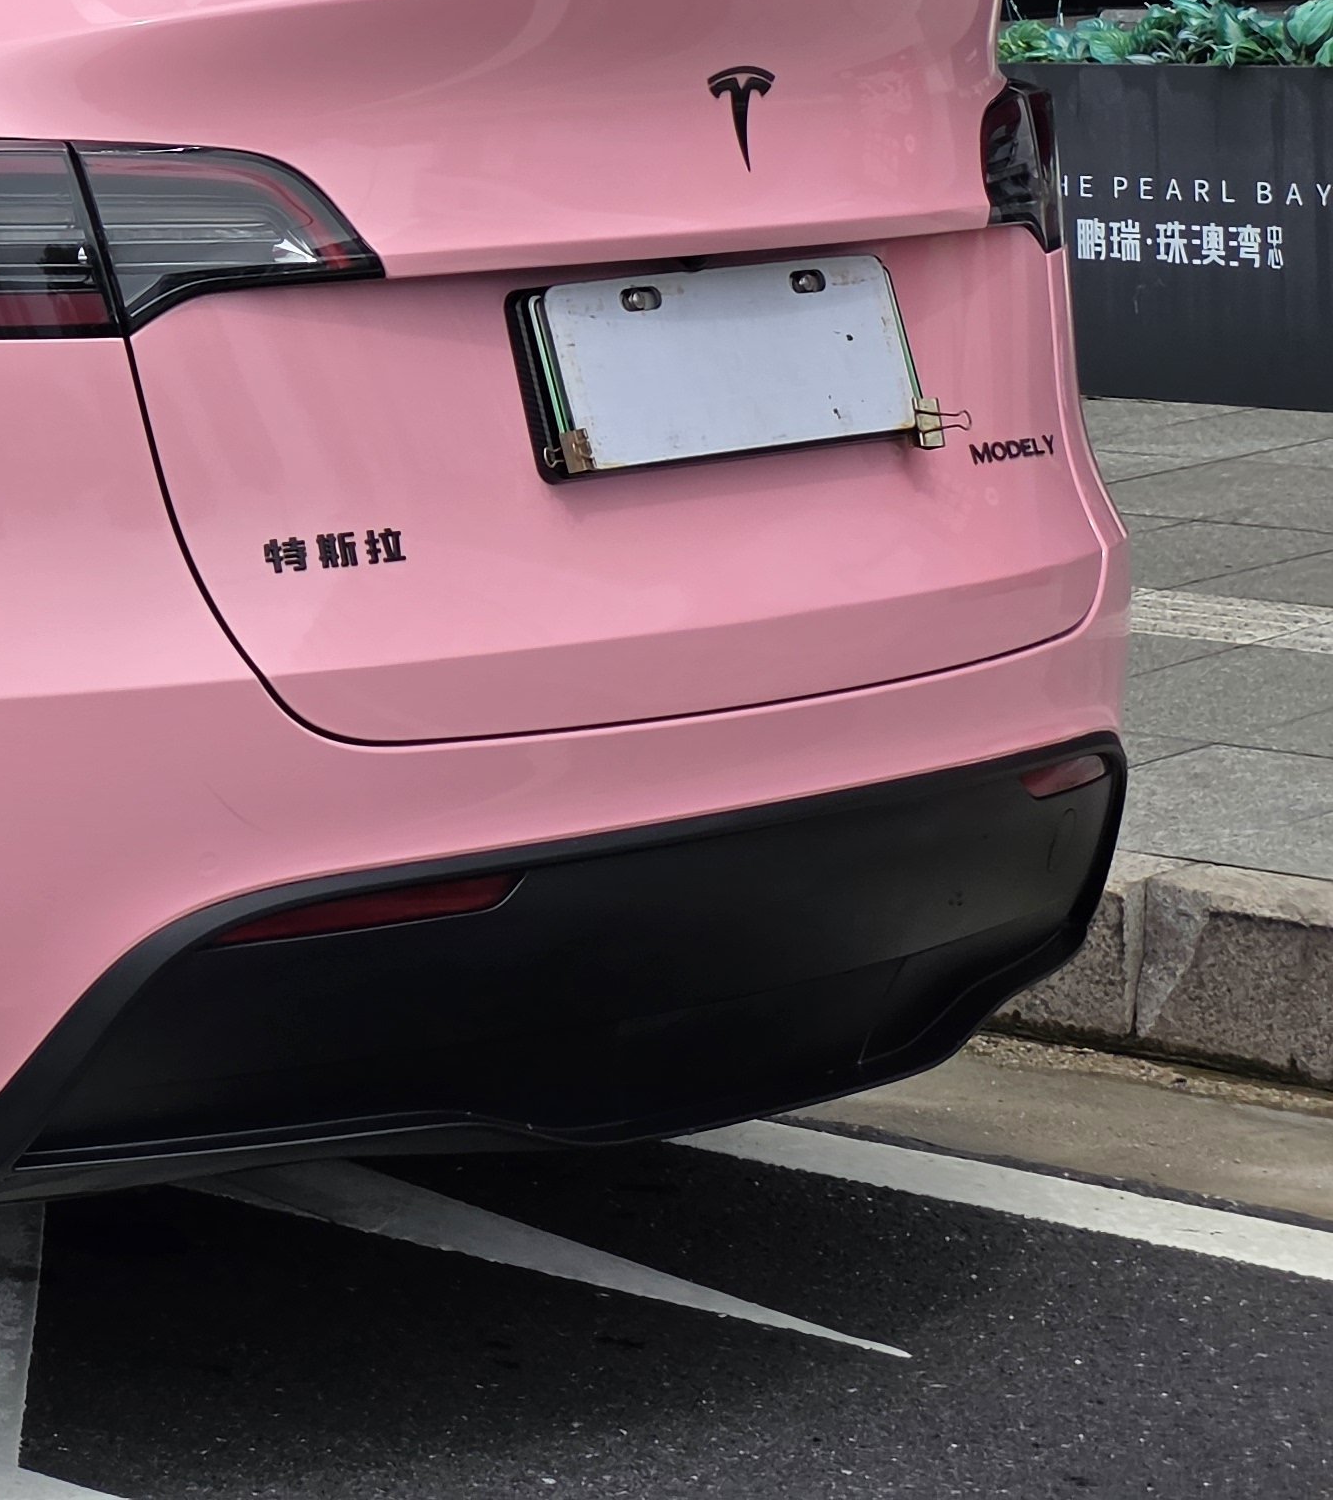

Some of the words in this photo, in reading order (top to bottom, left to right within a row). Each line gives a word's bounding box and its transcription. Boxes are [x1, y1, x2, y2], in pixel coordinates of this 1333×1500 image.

[1112, 176, 1236, 204] PEARL
[1255, 180, 1332, 207] BAY
[262, 528, 407, 574] 特斯拉
